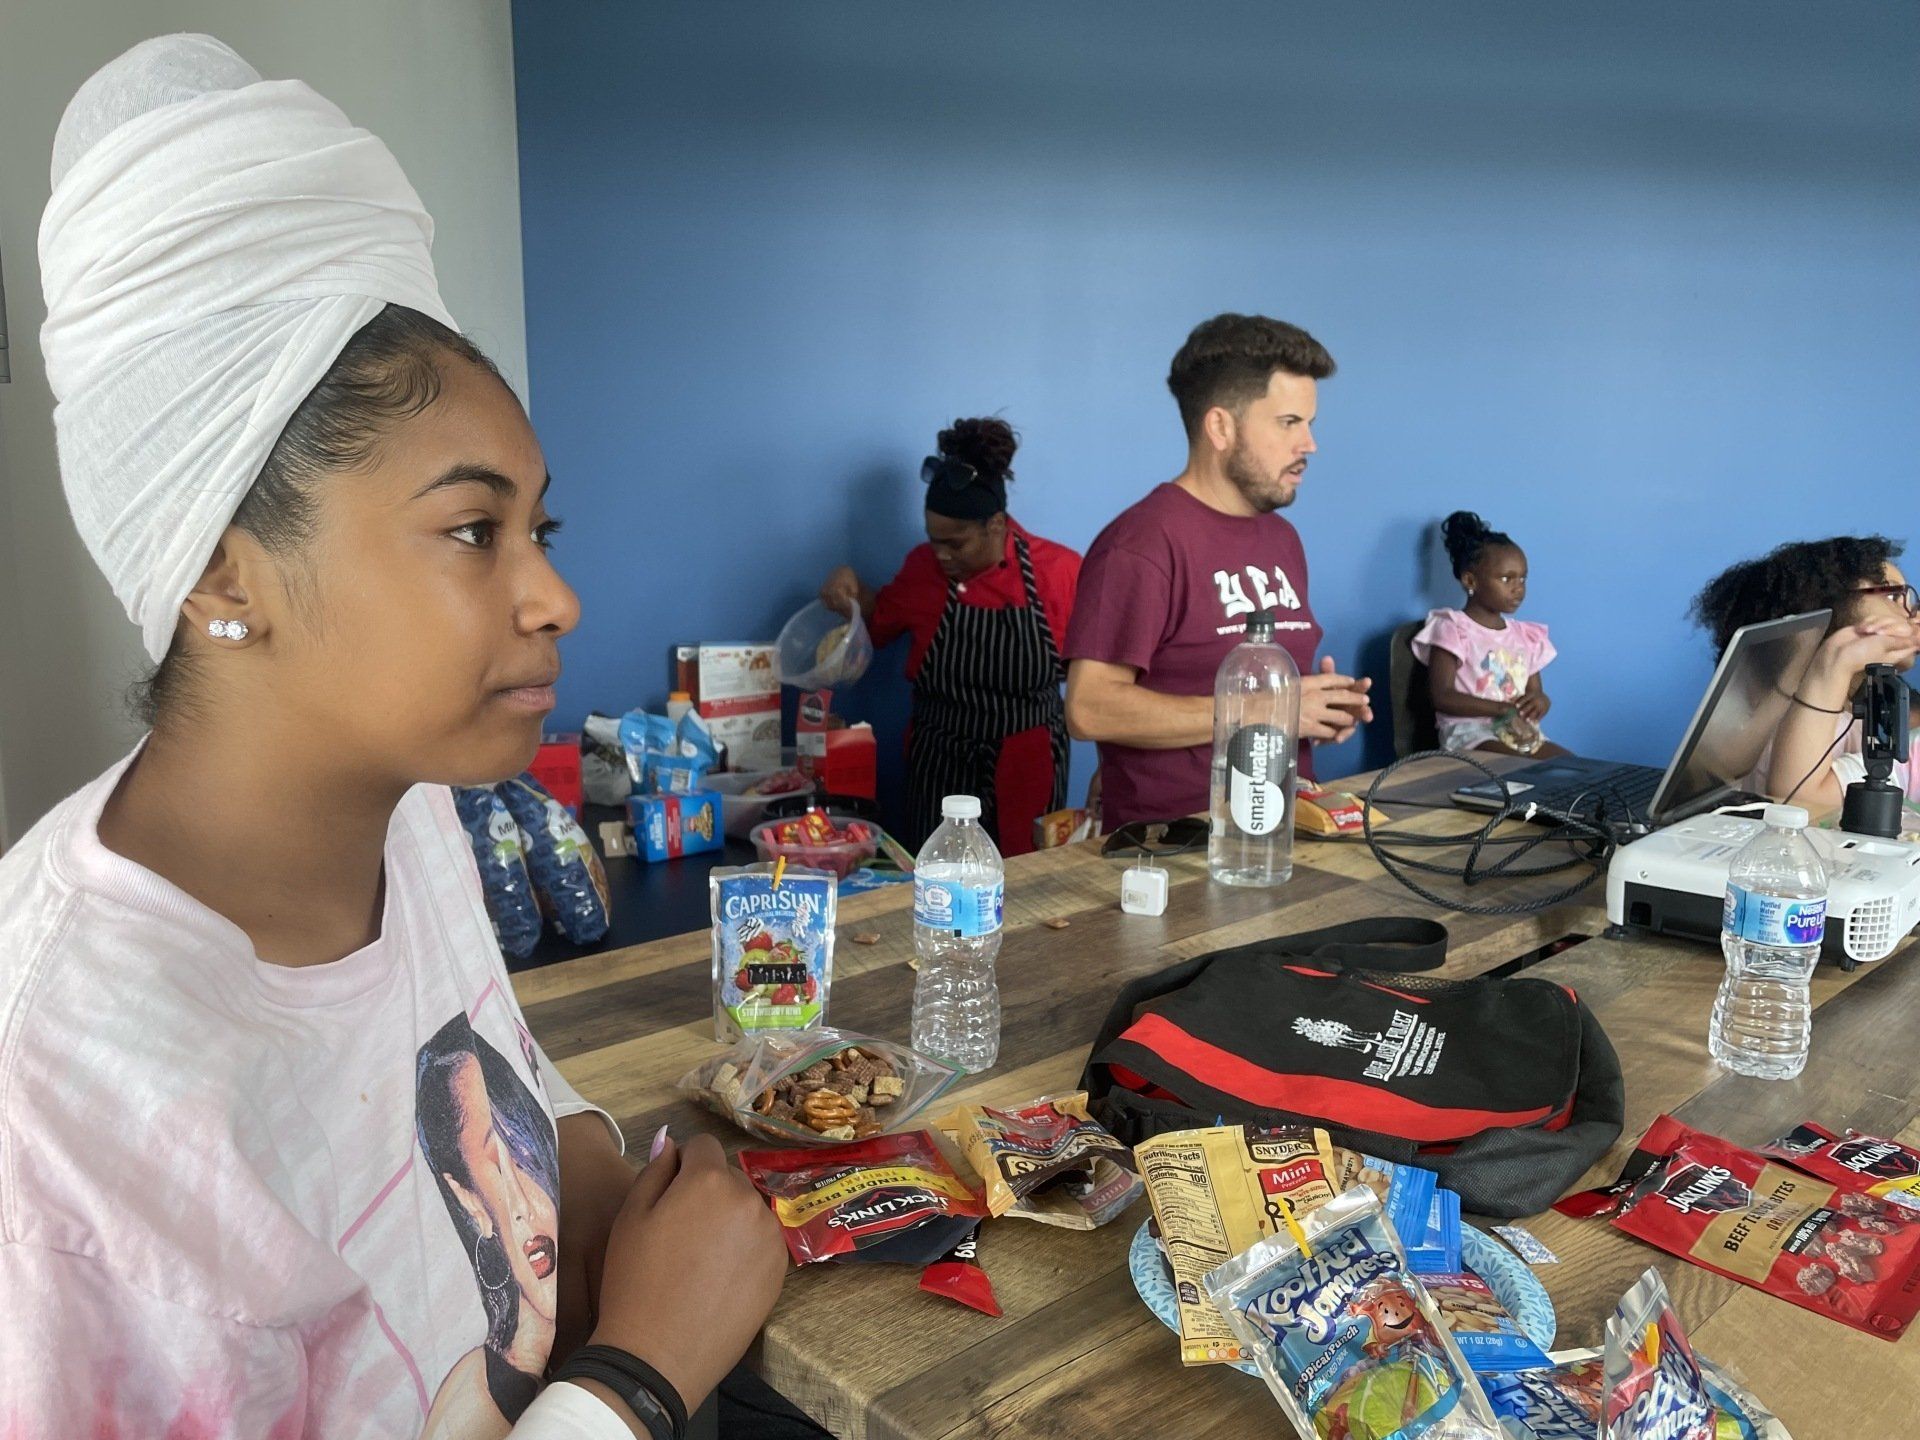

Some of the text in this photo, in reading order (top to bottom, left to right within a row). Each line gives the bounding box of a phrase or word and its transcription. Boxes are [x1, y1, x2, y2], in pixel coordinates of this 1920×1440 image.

[1143, 1149, 1200, 1161] Nutrition Facts
[846, 1176, 912, 1194] TENDER
[1150, 1171, 1207, 1184] Calories 100
[1272, 1162, 1311, 1185] Mini
[796, 1192, 842, 1215] BITES
[1666, 1187, 1705, 1214] JACK
[827, 1200, 898, 1228] LINK'S
[1724, 1221, 1751, 1253] BEEF
[1769, 1180, 1796, 1205] BITES
[1297, 1252, 1399, 1344] Jammers
[1457, 1337, 1468, 1345] WT
[1294, 1325, 1359, 1399] Tropical Punch
